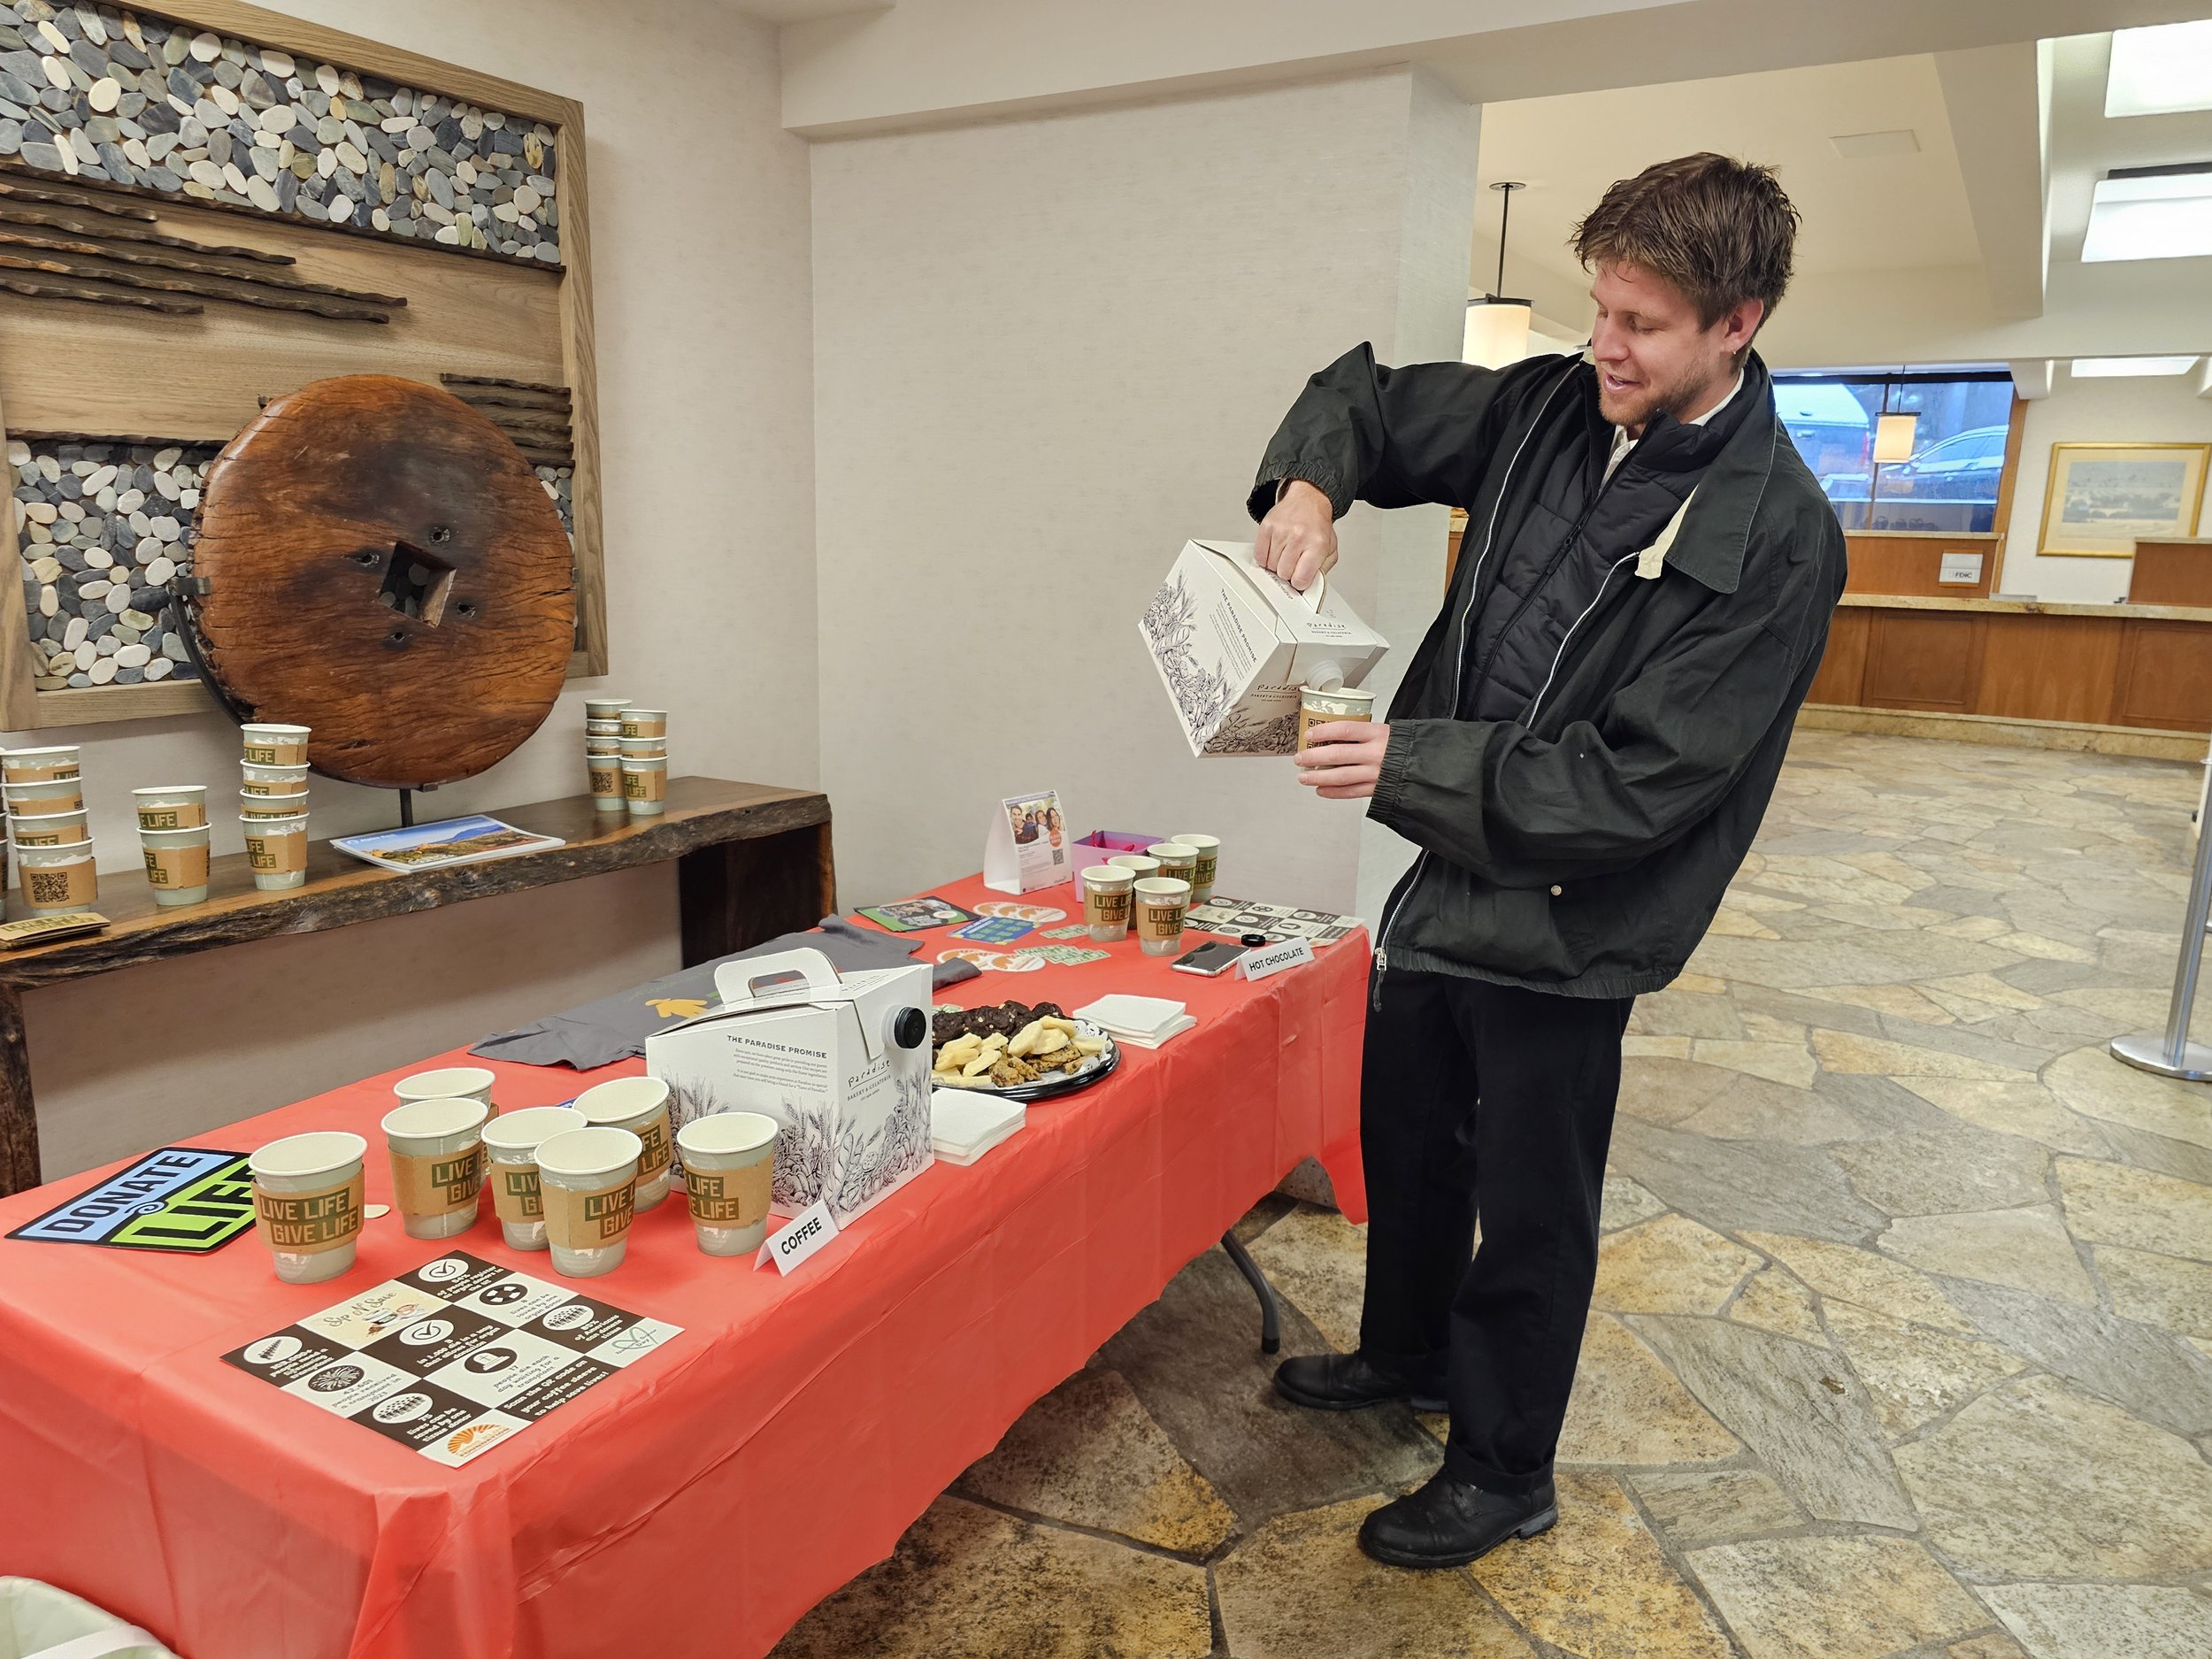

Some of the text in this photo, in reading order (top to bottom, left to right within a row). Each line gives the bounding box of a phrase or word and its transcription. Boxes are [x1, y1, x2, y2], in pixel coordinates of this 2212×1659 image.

[1226, 602, 1243, 634] PARADISE
[1241, 634, 1257, 664] PROMISE
[249, 749, 273, 763] LIFE
[147, 813, 175, 826] LIFE
[252, 856, 274, 867] LIFE
[1096, 896, 1118, 908] LIVE
[1103, 909, 1124, 920] GIVE
[1150, 910, 1172, 921] LIVE
[1158, 923, 1179, 934] GIVE
[1249, 948, 1304, 972] HOT CHOCOLATE
[727, 1035, 827, 1058] THE PARADISE PROMISE
[848, 1060, 890, 1087] Paradise
[437, 1157, 473, 1183] LIVE
[641, 1144, 669, 1173] LIFE
[40, 1156, 204, 1233] DONATE
[451, 1177, 478, 1202] GIVE
[509, 1174, 538, 1193] LIV
[688, 1174, 720, 1197] LIFE
[261, 1192, 347, 1220] LIVE LIFE
[589, 1188, 627, 1217] LIVE
[700, 1200, 736, 1219] LIFE
[273, 1210, 357, 1244] GIVE LIFE
[604, 1205, 633, 1236] GIVE
[781, 1217, 822, 1255] COFFEE
[324, 1292, 397, 1328] Sip N Save
[584, 1315, 619, 1335] Americans
[493, 1373, 518, 1389] people
[532, 1355, 550, 1366] each
[497, 1383, 514, 1393] day
[513, 1367, 541, 1386] waiting
[541, 1359, 553, 1369] for
[503, 1359, 588, 1409] Scan the QR code on
[518, 1365, 556, 1388] transplant
[520, 1366, 598, 1414] your coffee sleeve
[534, 1371, 610, 1417] to help save lives!
[406, 1422, 429, 1435] lives
[429, 1416, 444, 1425] can
[413, 1409, 467, 1440] saved by one
[422, 1427, 449, 1442] tissue
[448, 1413, 472, 1429] donor
